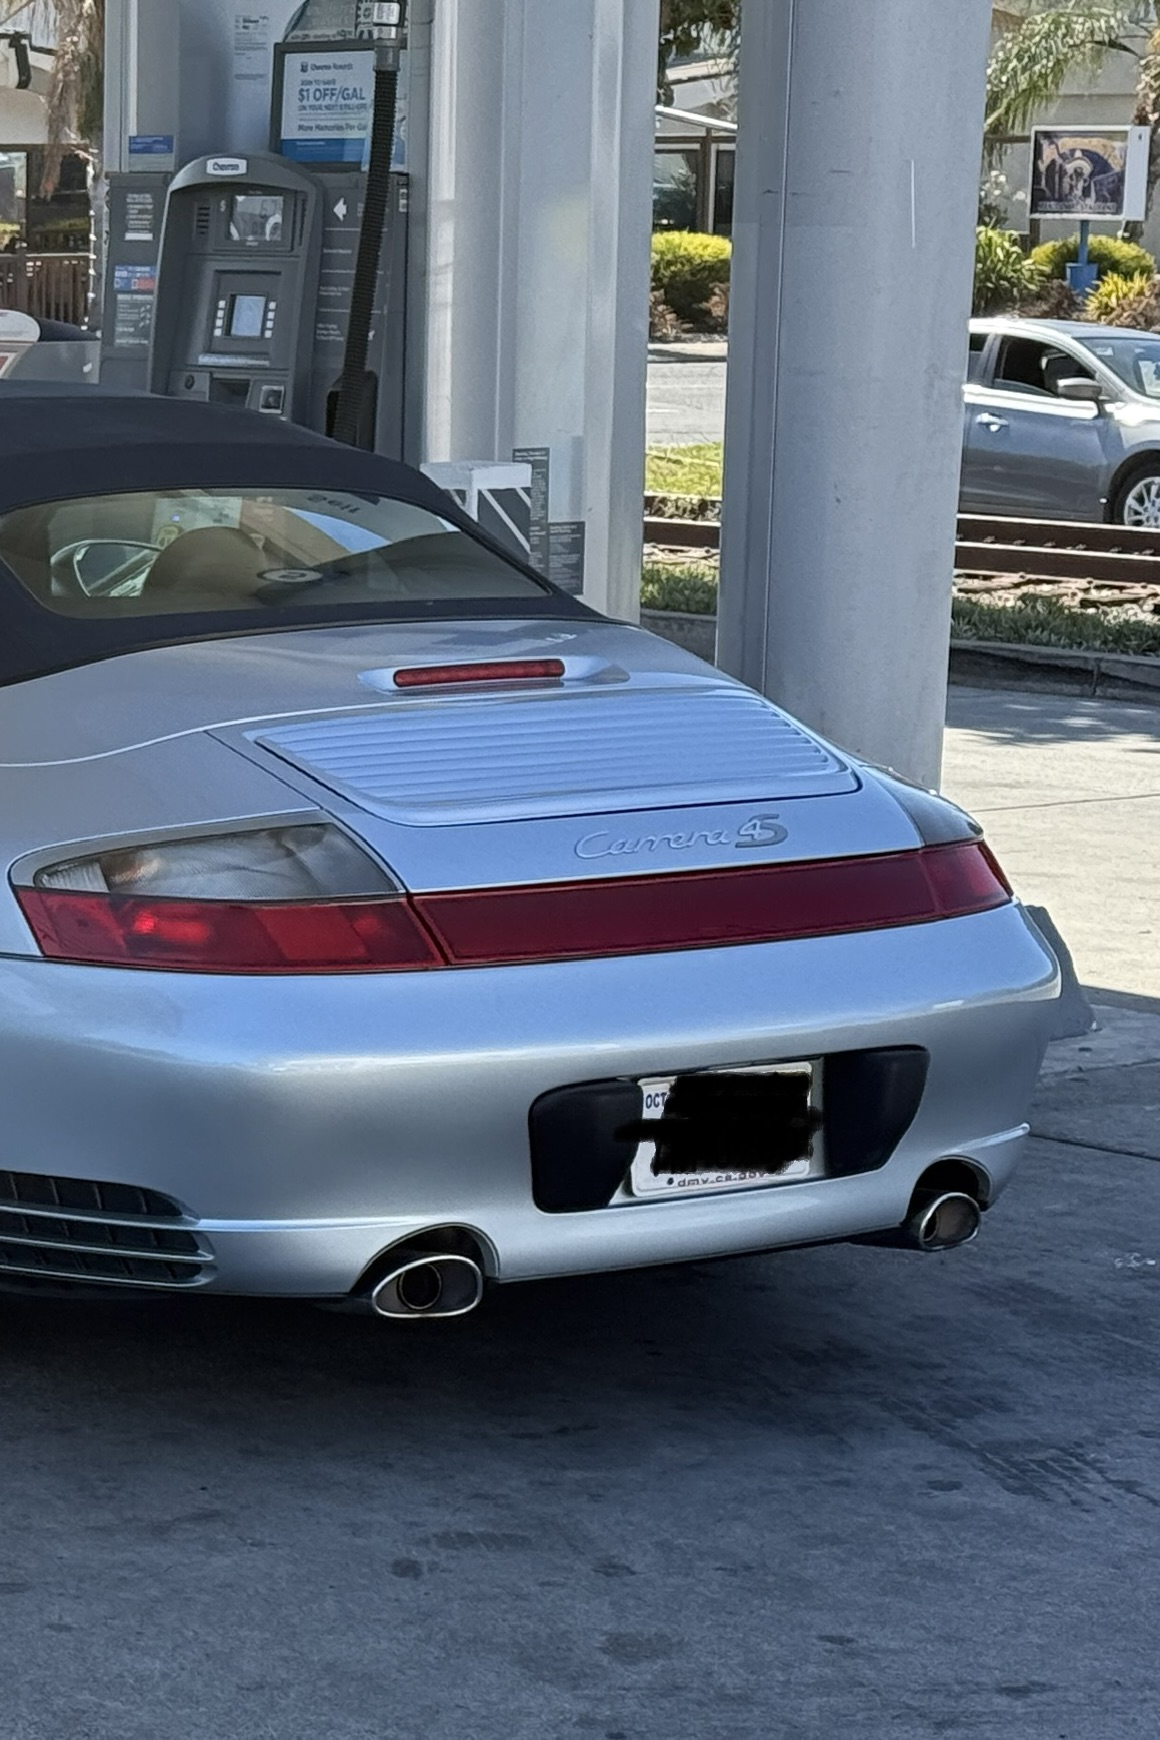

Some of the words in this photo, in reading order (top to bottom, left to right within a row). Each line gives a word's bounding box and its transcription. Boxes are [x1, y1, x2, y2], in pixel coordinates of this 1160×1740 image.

[298, 87, 311, 103] $1
[313, 86, 366, 103] OFF/GAL
[574, 829, 730, 860] Carrera
[734, 813, 789, 849] 4S
[645, 1091, 668, 1109] OCT
